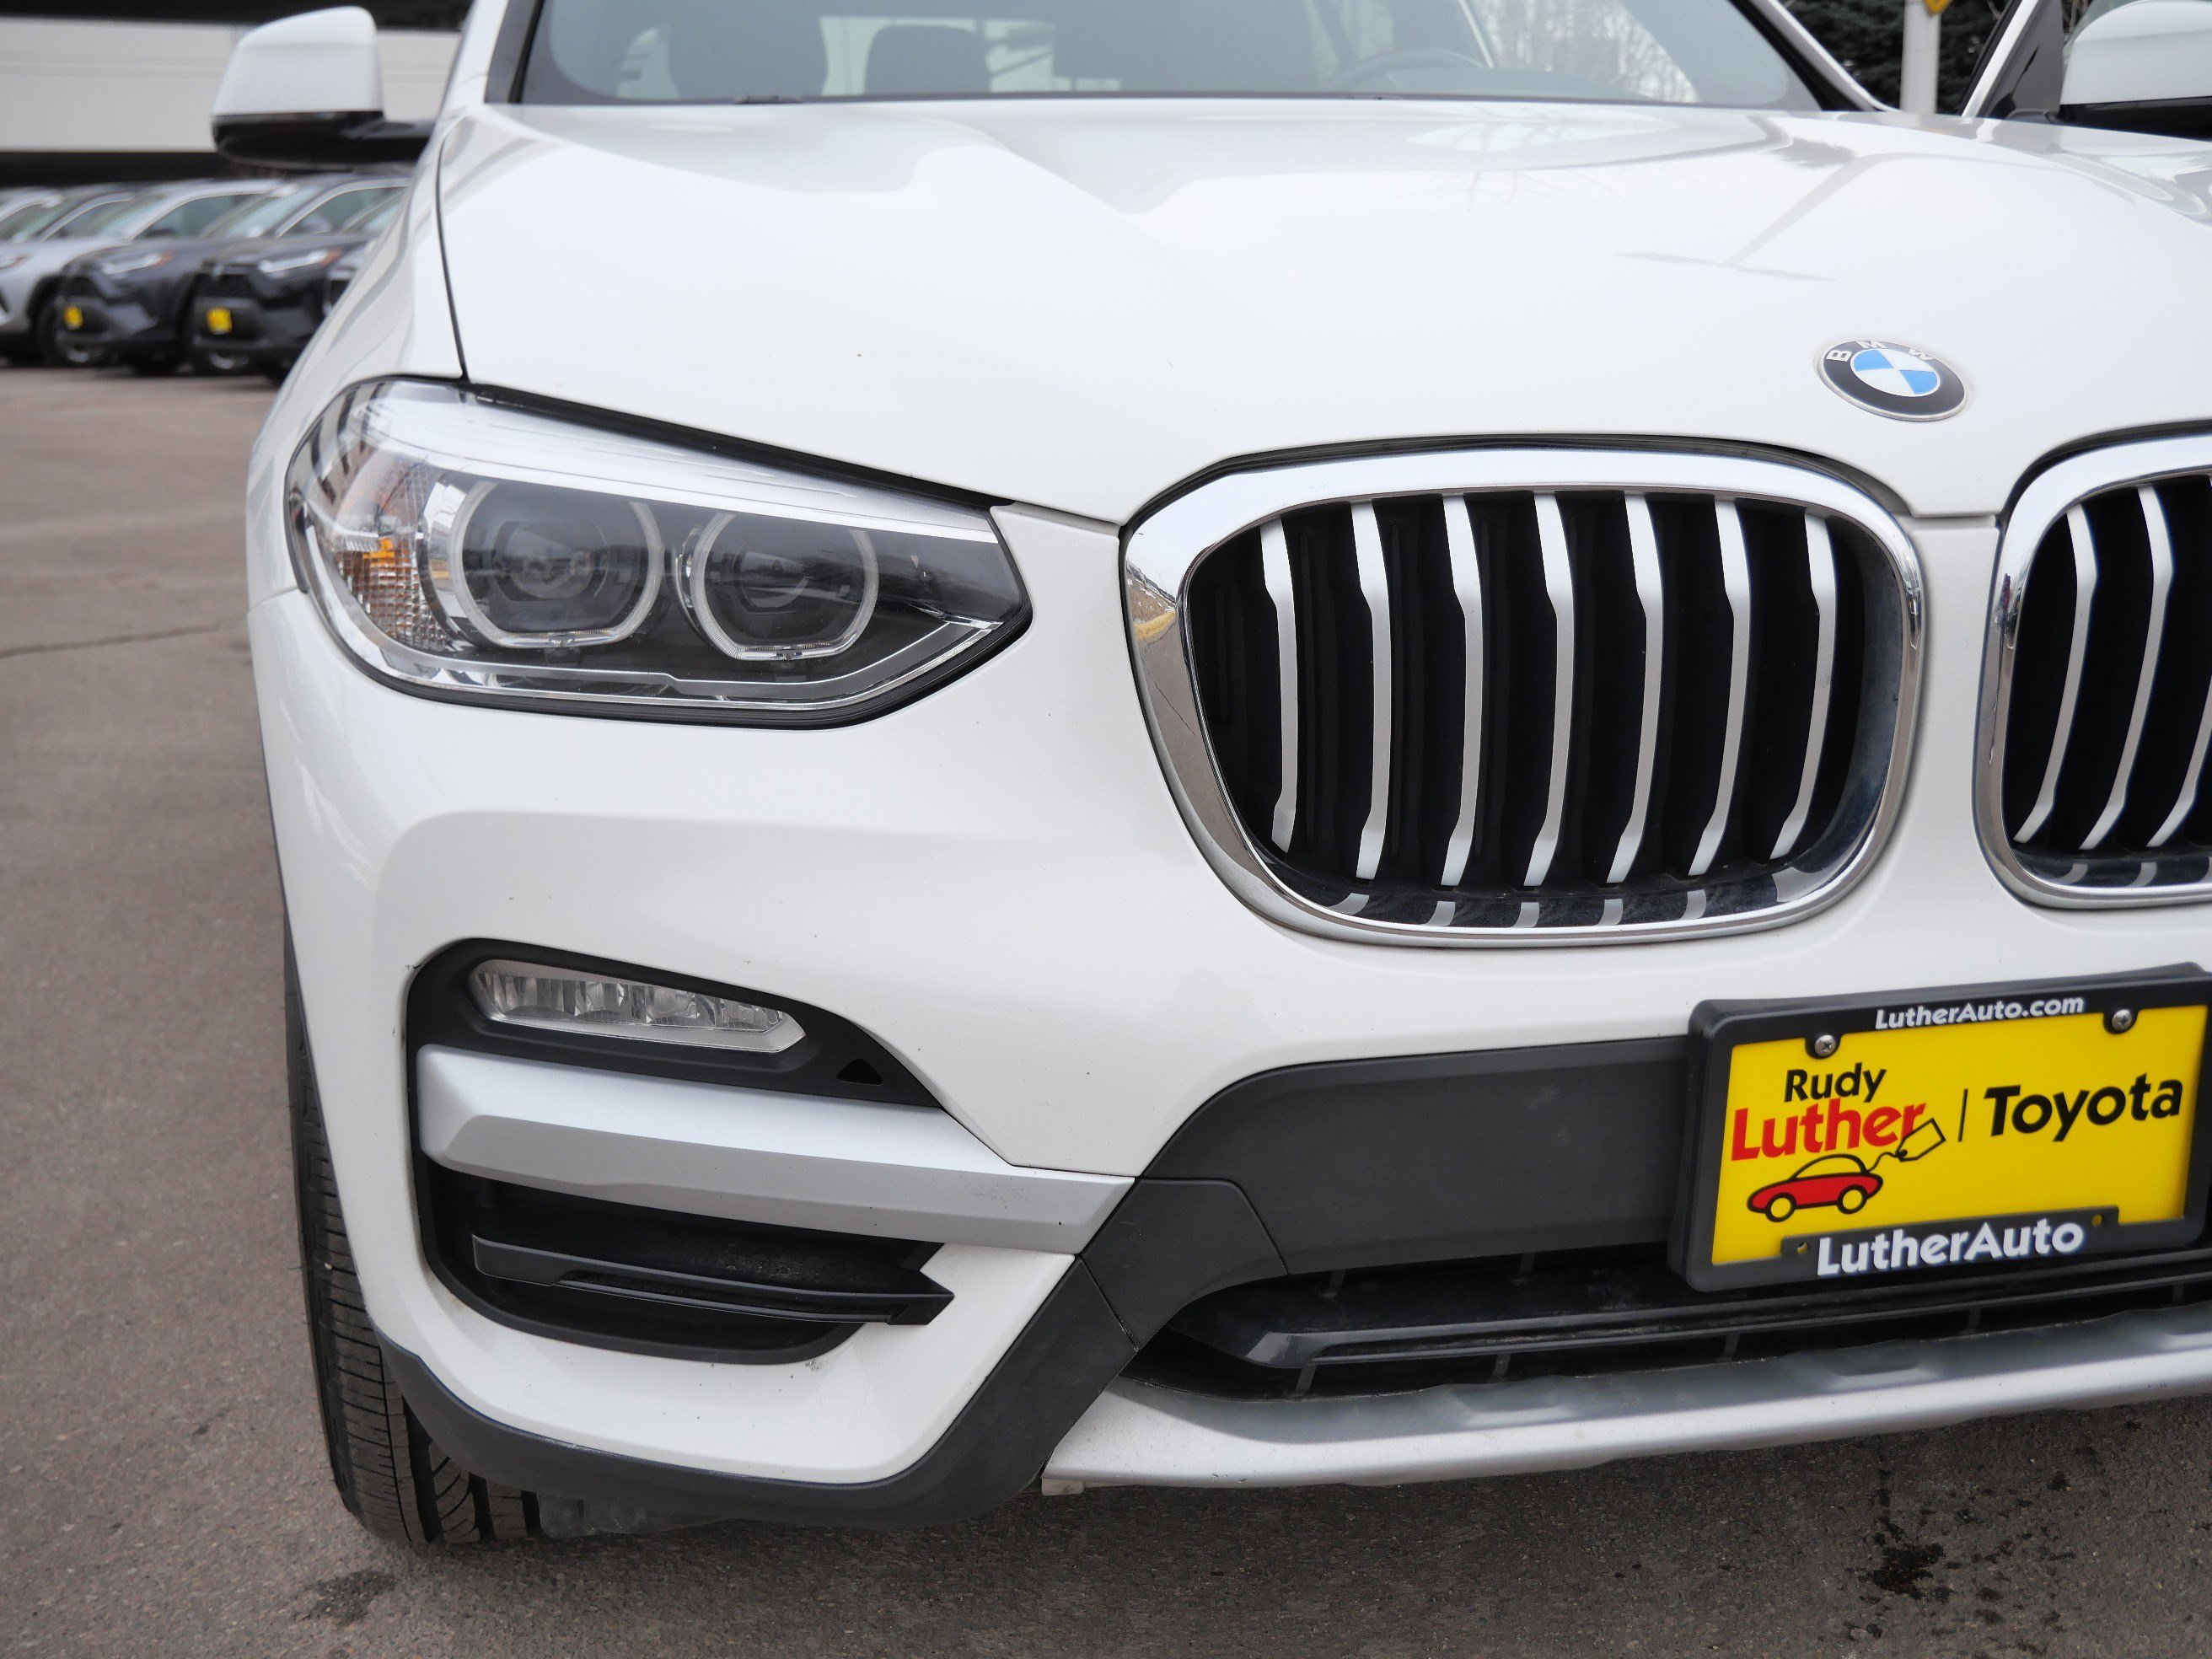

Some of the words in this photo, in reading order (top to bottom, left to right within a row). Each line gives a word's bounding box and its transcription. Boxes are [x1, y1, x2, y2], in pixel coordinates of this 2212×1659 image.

[1825, 340, 1936, 362] BMW
[1874, 996, 2085, 1030] LutherAuto.com
[1784, 1061, 1887, 1103] Rudy
[1984, 1072, 2183, 1141] Toyota
[1731, 1097, 1927, 1162] Luther
[1816, 1217, 2085, 1278] LutherAuto
